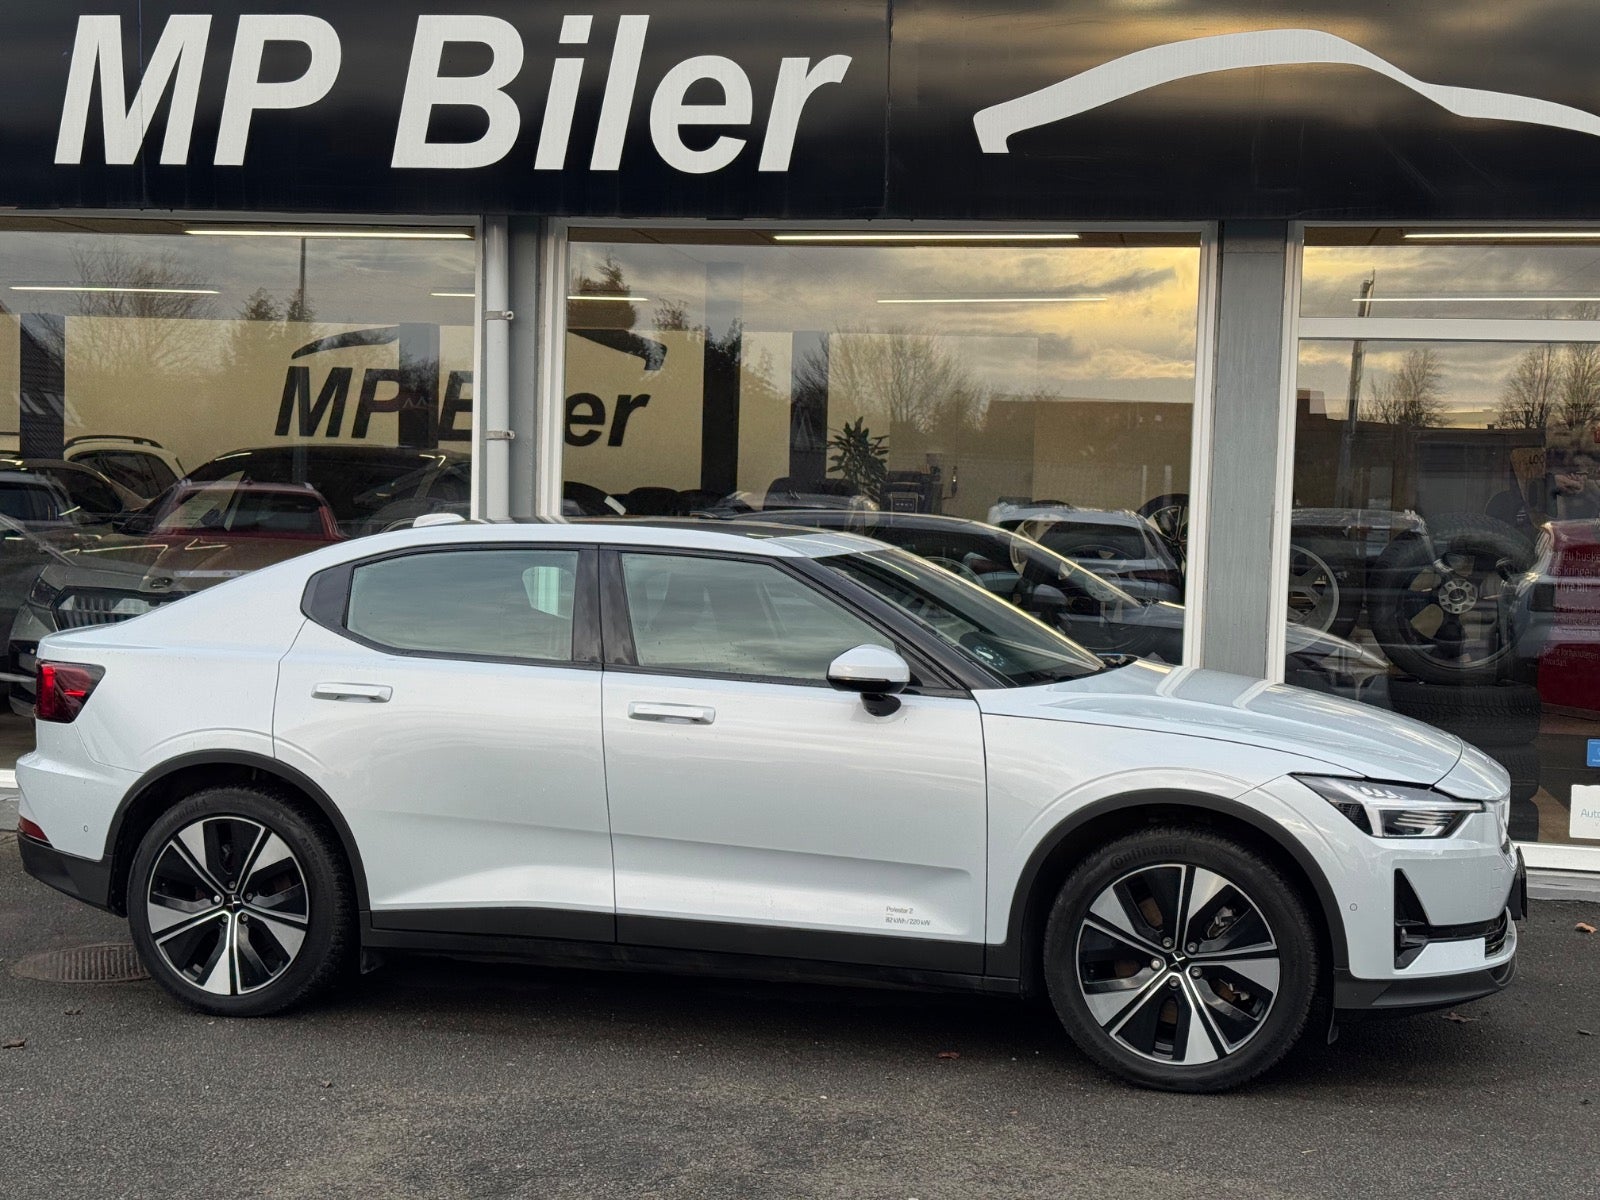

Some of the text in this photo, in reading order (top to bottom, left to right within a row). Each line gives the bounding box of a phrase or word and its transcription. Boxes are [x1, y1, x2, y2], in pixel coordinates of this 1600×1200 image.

[54, 15, 852, 174] MP Biler
[274, 366, 401, 439] MP
